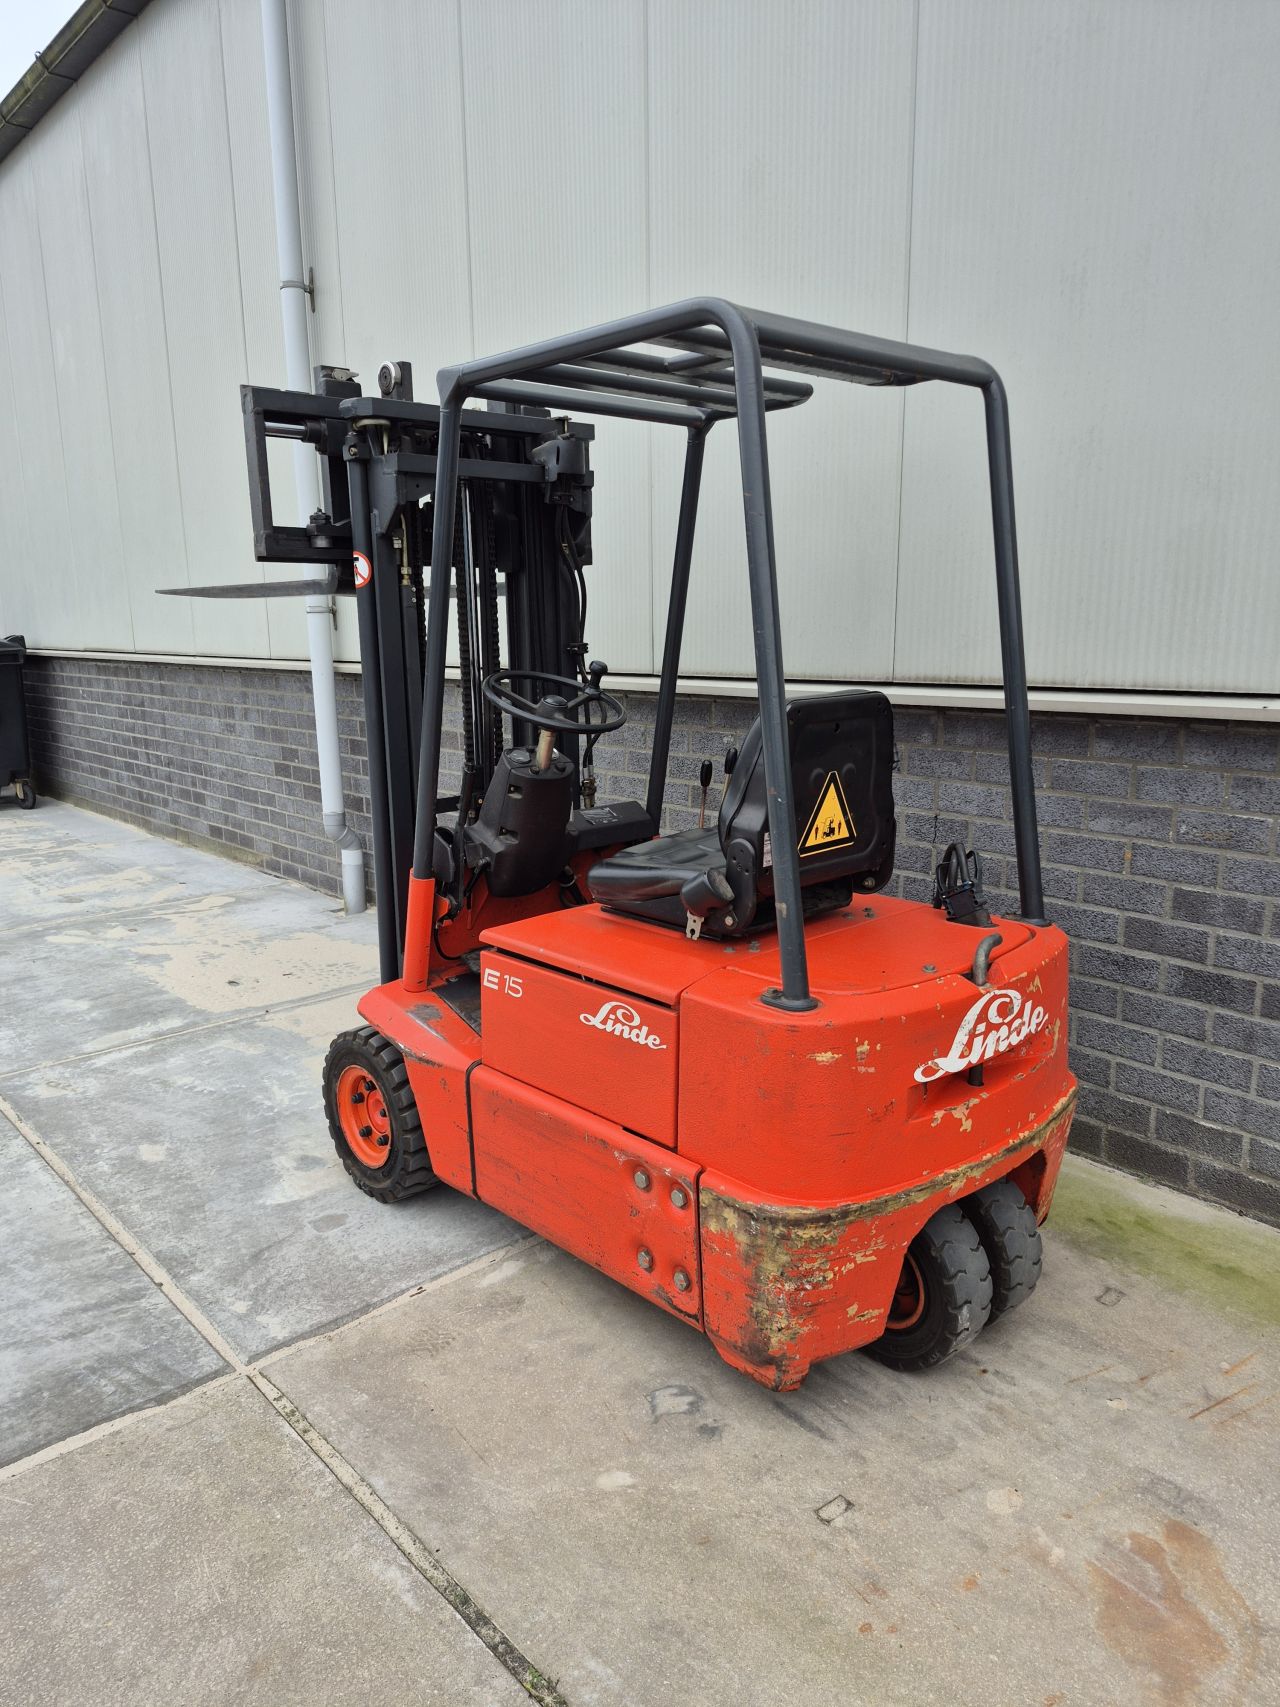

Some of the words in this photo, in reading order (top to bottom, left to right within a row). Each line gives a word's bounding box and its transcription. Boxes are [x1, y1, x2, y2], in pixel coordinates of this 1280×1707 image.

[483, 967, 501, 991] E
[503, 974, 523, 998] 15
[579, 1001, 667, 1050] Linde
[913, 989, 1048, 1083] Linde
